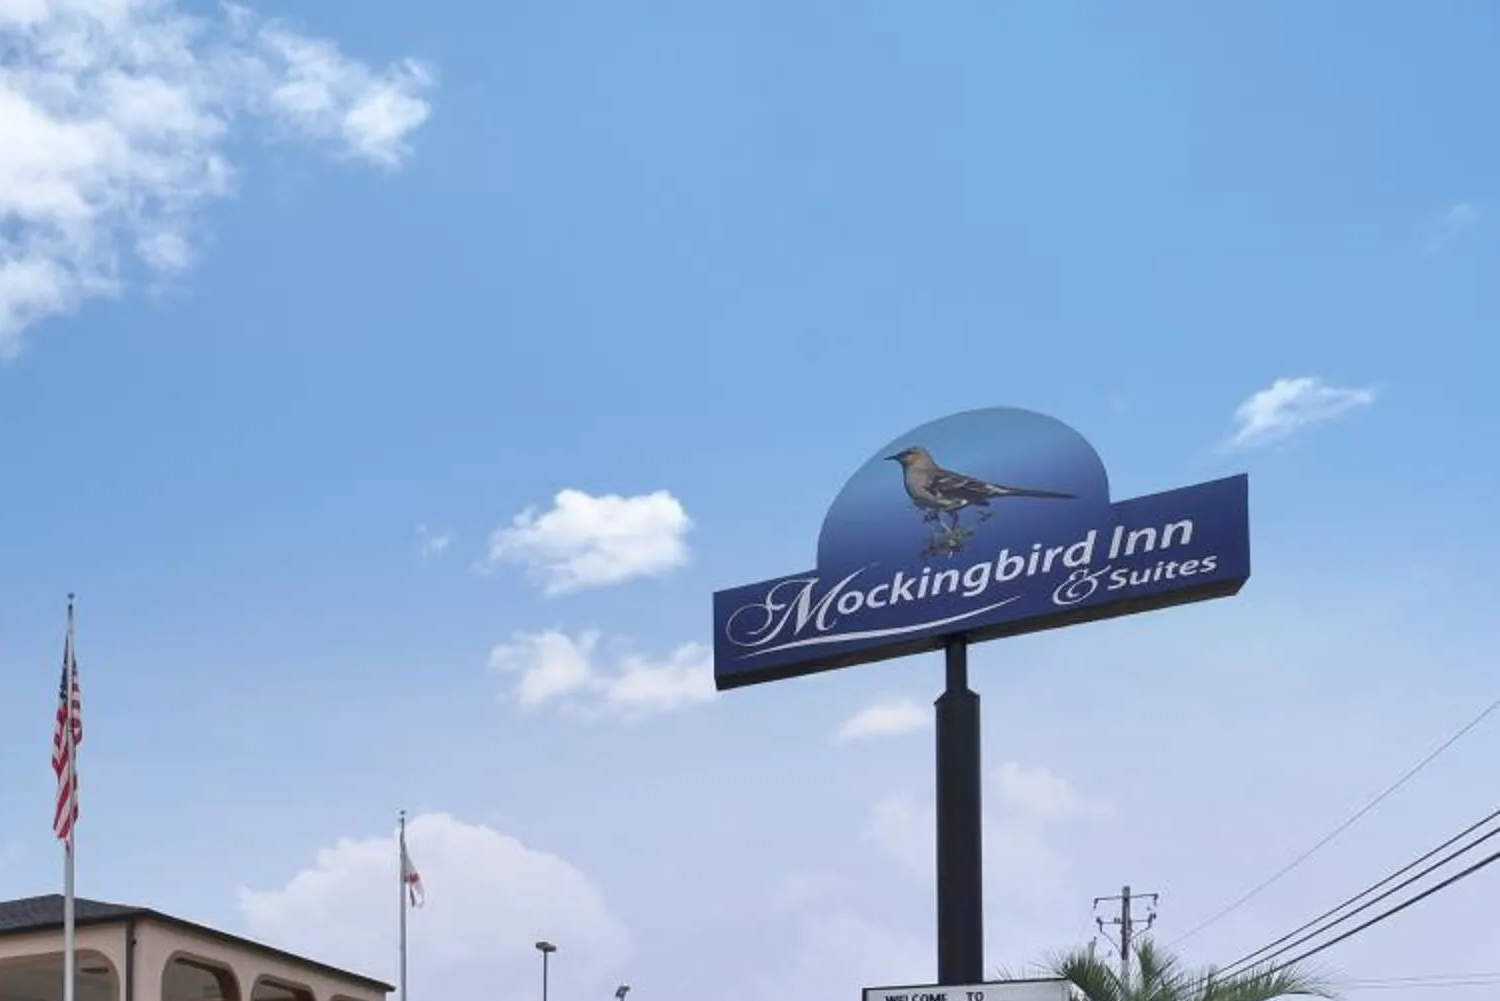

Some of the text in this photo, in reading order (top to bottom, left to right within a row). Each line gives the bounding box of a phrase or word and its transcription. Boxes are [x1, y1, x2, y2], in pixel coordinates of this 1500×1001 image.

[726, 517, 1194, 648] Mockingbird Inn
[1053, 554, 1218, 606] & Suites
